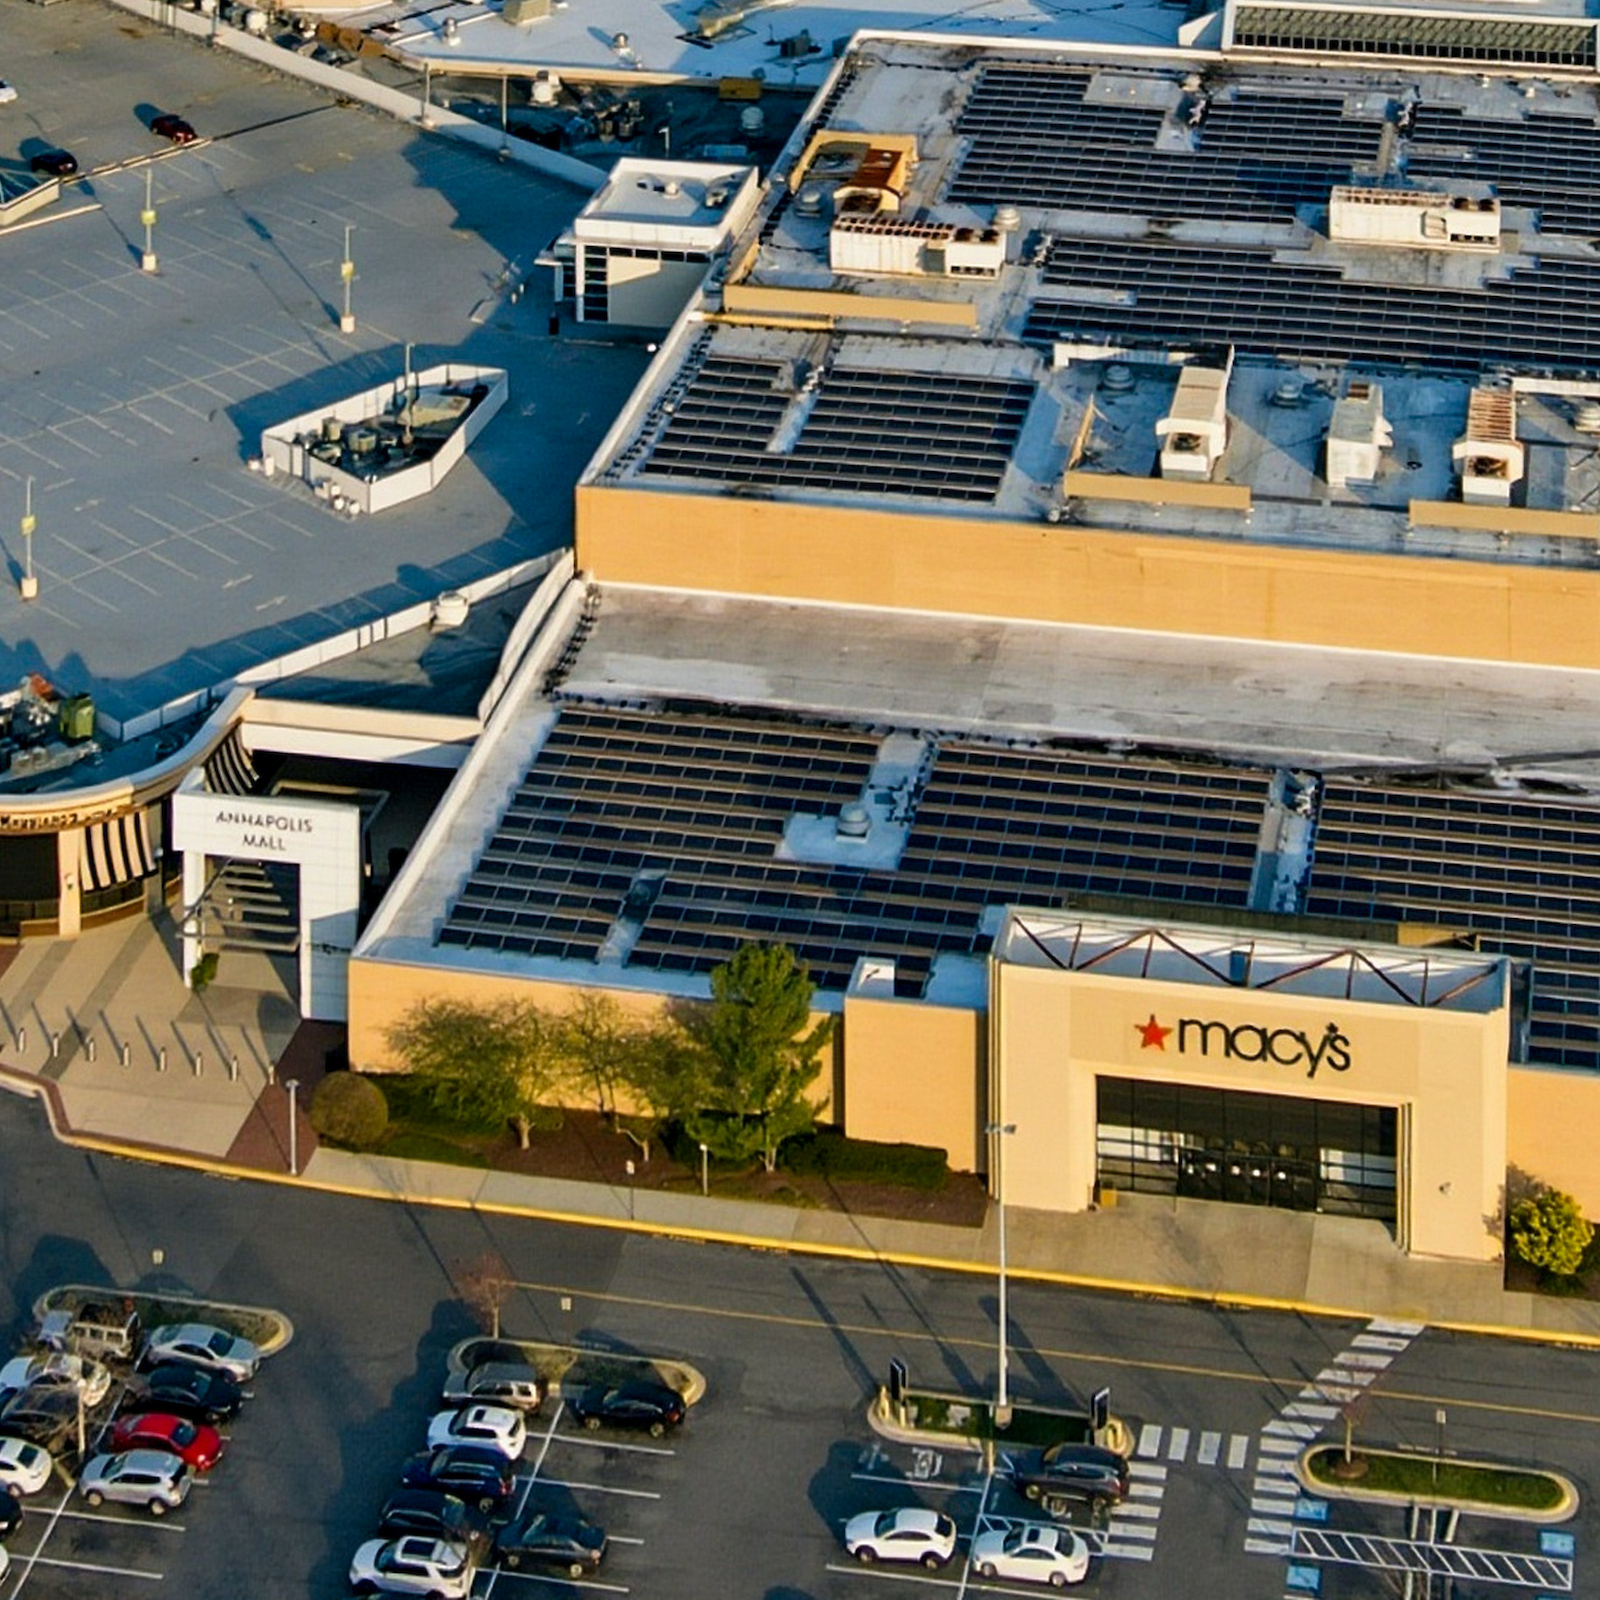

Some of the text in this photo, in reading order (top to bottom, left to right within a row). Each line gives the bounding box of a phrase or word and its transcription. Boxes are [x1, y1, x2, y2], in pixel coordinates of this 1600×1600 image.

[215, 811, 313, 833] ANNAPOLIS
[242, 834, 287, 851] MALL
[1178, 1019, 1351, 1079] macy's
